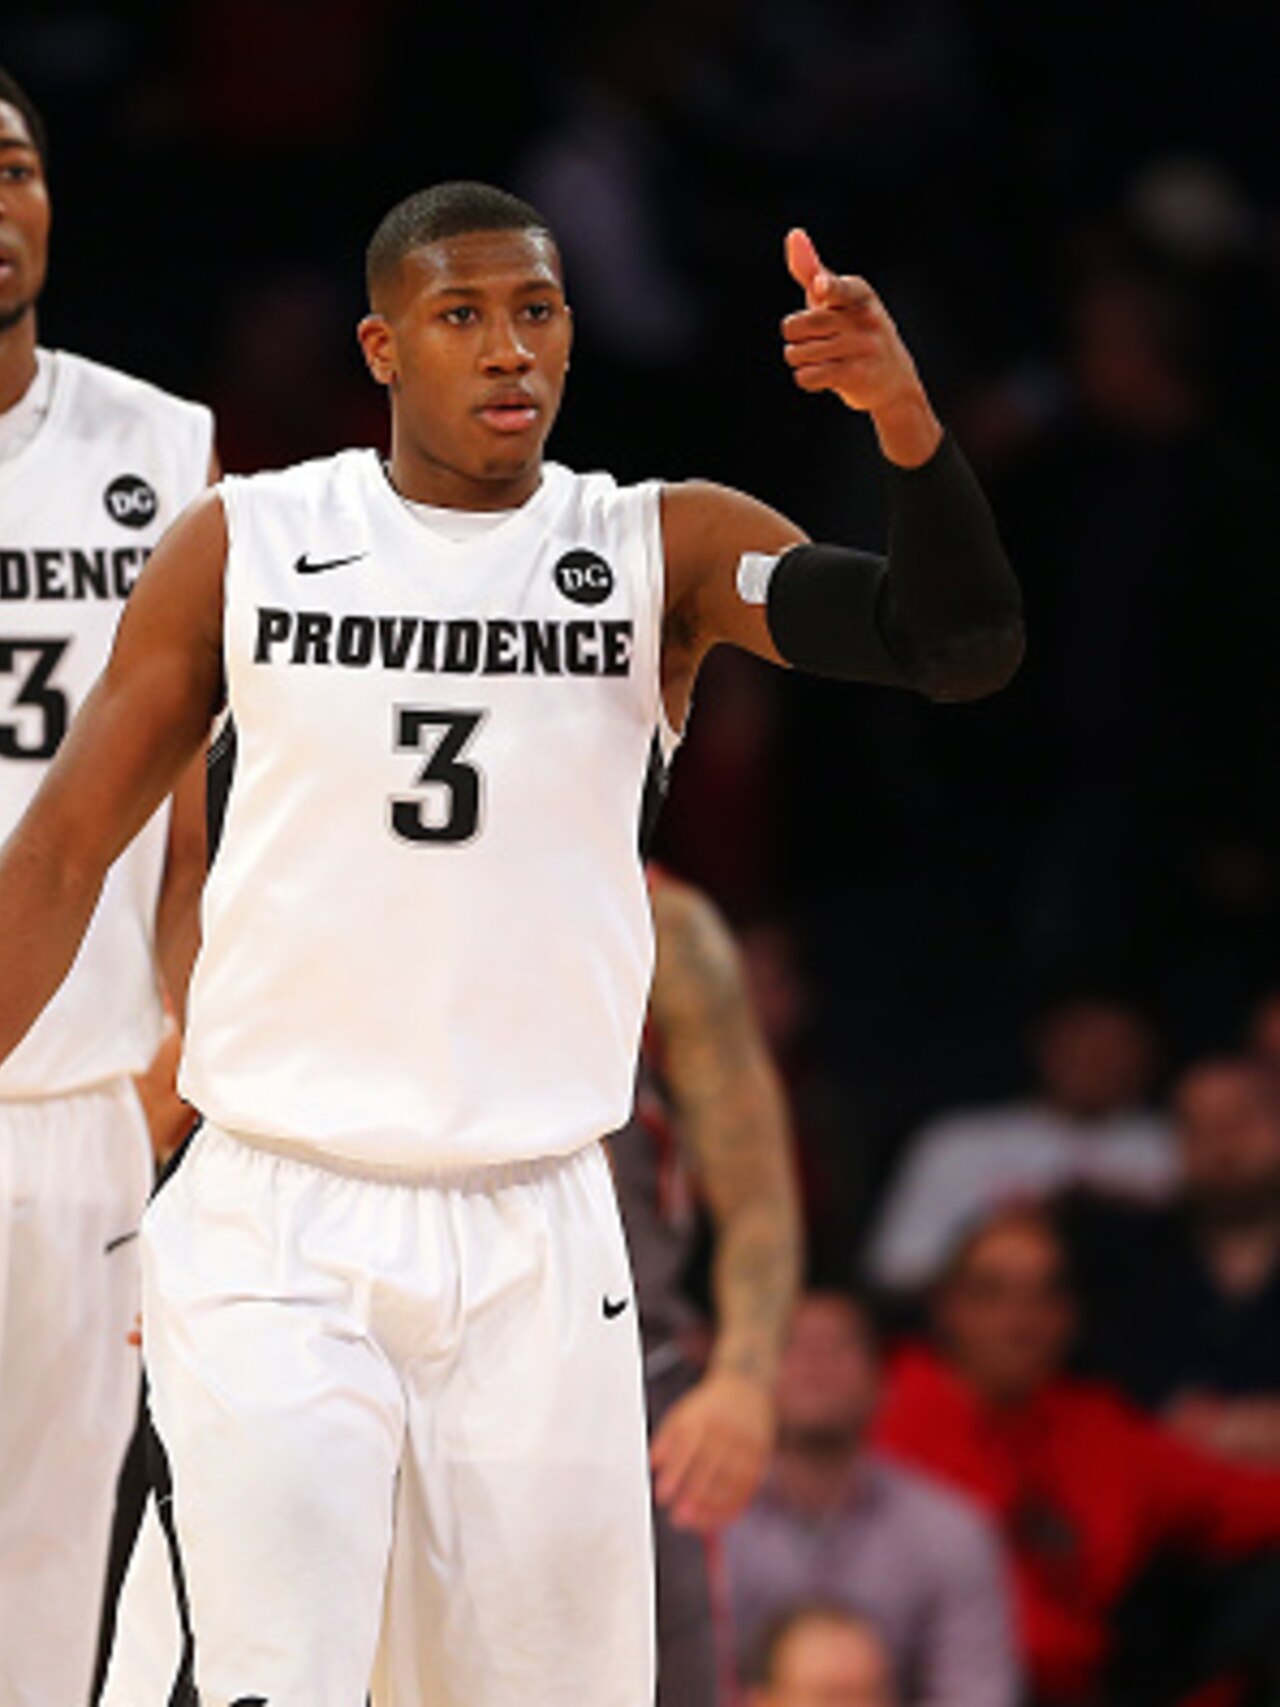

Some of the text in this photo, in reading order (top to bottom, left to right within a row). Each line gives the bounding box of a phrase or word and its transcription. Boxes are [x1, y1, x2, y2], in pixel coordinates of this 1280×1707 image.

[110, 486, 153, 517] DG
[560, 563, 608, 592] DG
[253, 607, 634, 678] PROVIDENCE
[391, 705, 487, 845] 3
